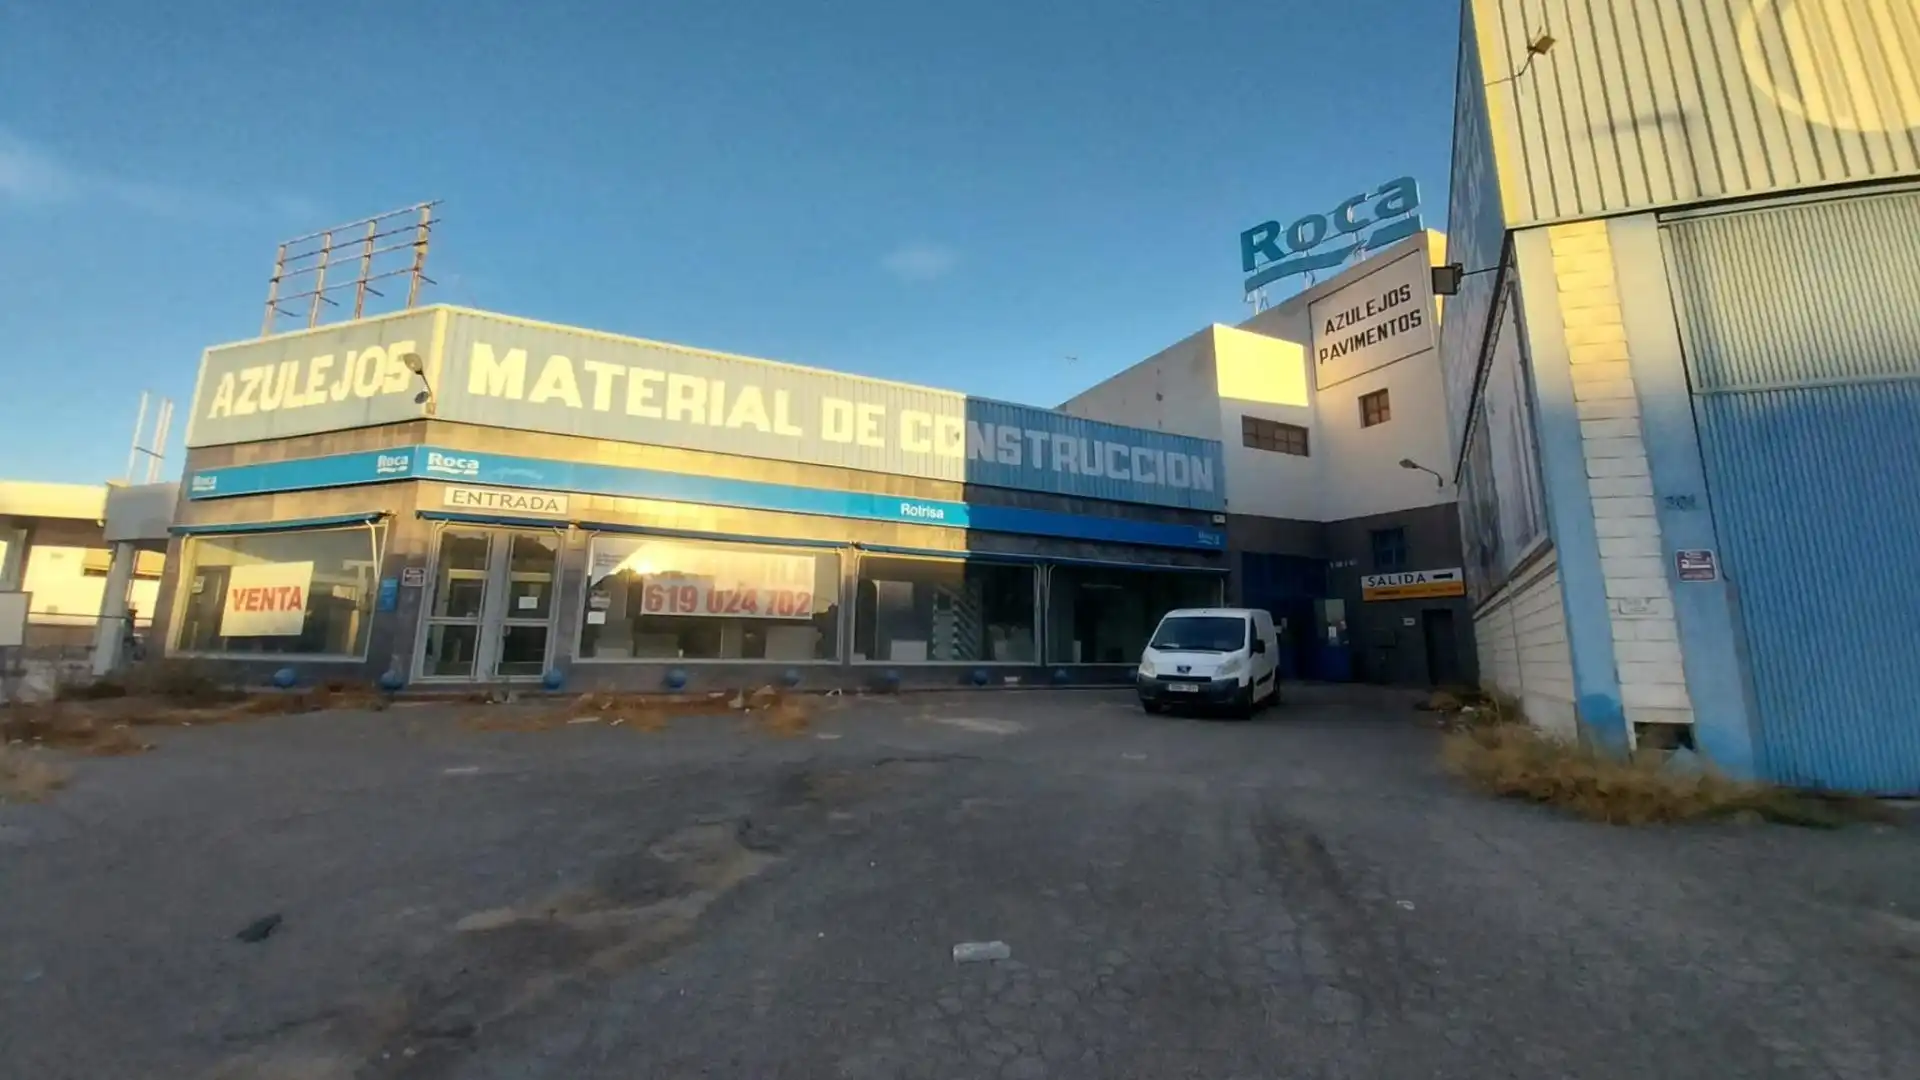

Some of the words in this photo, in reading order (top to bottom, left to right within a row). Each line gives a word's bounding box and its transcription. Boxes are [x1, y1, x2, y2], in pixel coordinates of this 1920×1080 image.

[1240, 176, 1420, 272] Roca
[1324, 283, 1412, 336] AZULEJOS
[1319, 308, 1422, 365] PAVIMENTOS
[207, 340, 416, 419] AZULEJOS
[468, 341, 803, 437] MATERIAL
[821, 397, 886, 447] DE
[899, 409, 1214, 491] CONSTRUCCION
[377, 454, 409, 468] Roca
[427, 452, 480, 469] Roca
[452, 489, 559, 512] ENTRADA
[900, 502, 944, 519] Rotrisa
[1367, 573, 1427, 588] SALIDA
[232, 586, 302, 612] VENTA
[644, 584, 698, 613] 619
[706, 588, 759, 614] 024
[766, 590, 812, 617] 702
